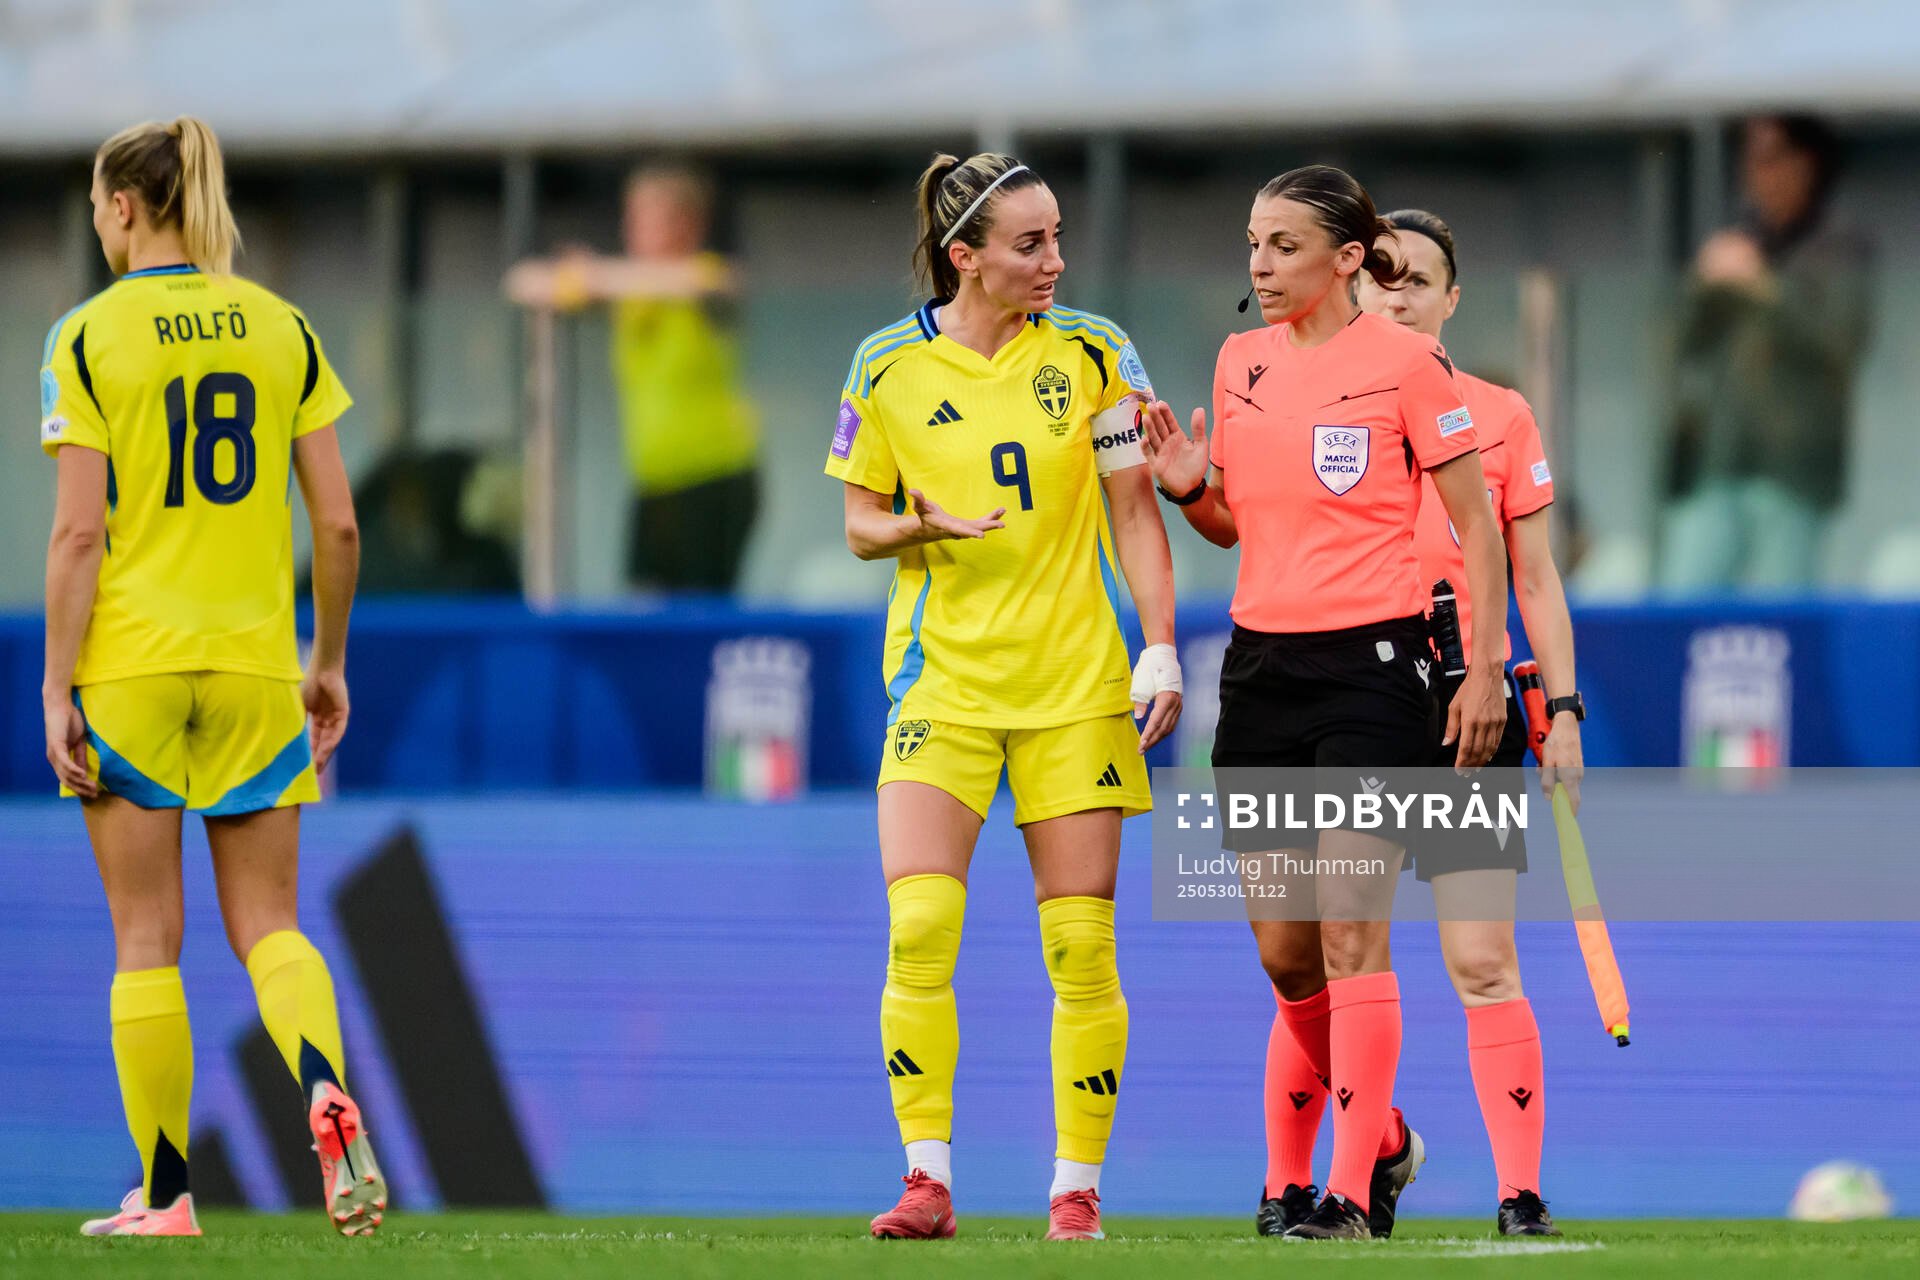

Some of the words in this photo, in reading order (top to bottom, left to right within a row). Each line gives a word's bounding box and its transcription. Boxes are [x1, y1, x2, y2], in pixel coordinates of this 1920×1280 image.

[154, 303, 248, 345] ROLFÖ
[164, 372, 256, 508] 18
[1092, 428, 1137, 453] #ONE
[1324, 434, 1357, 447] UEFA
[1320, 465, 1359, 473] OFFICIAL
[1324, 455, 1356, 463] MATCH
[990, 441, 1034, 512] 9
